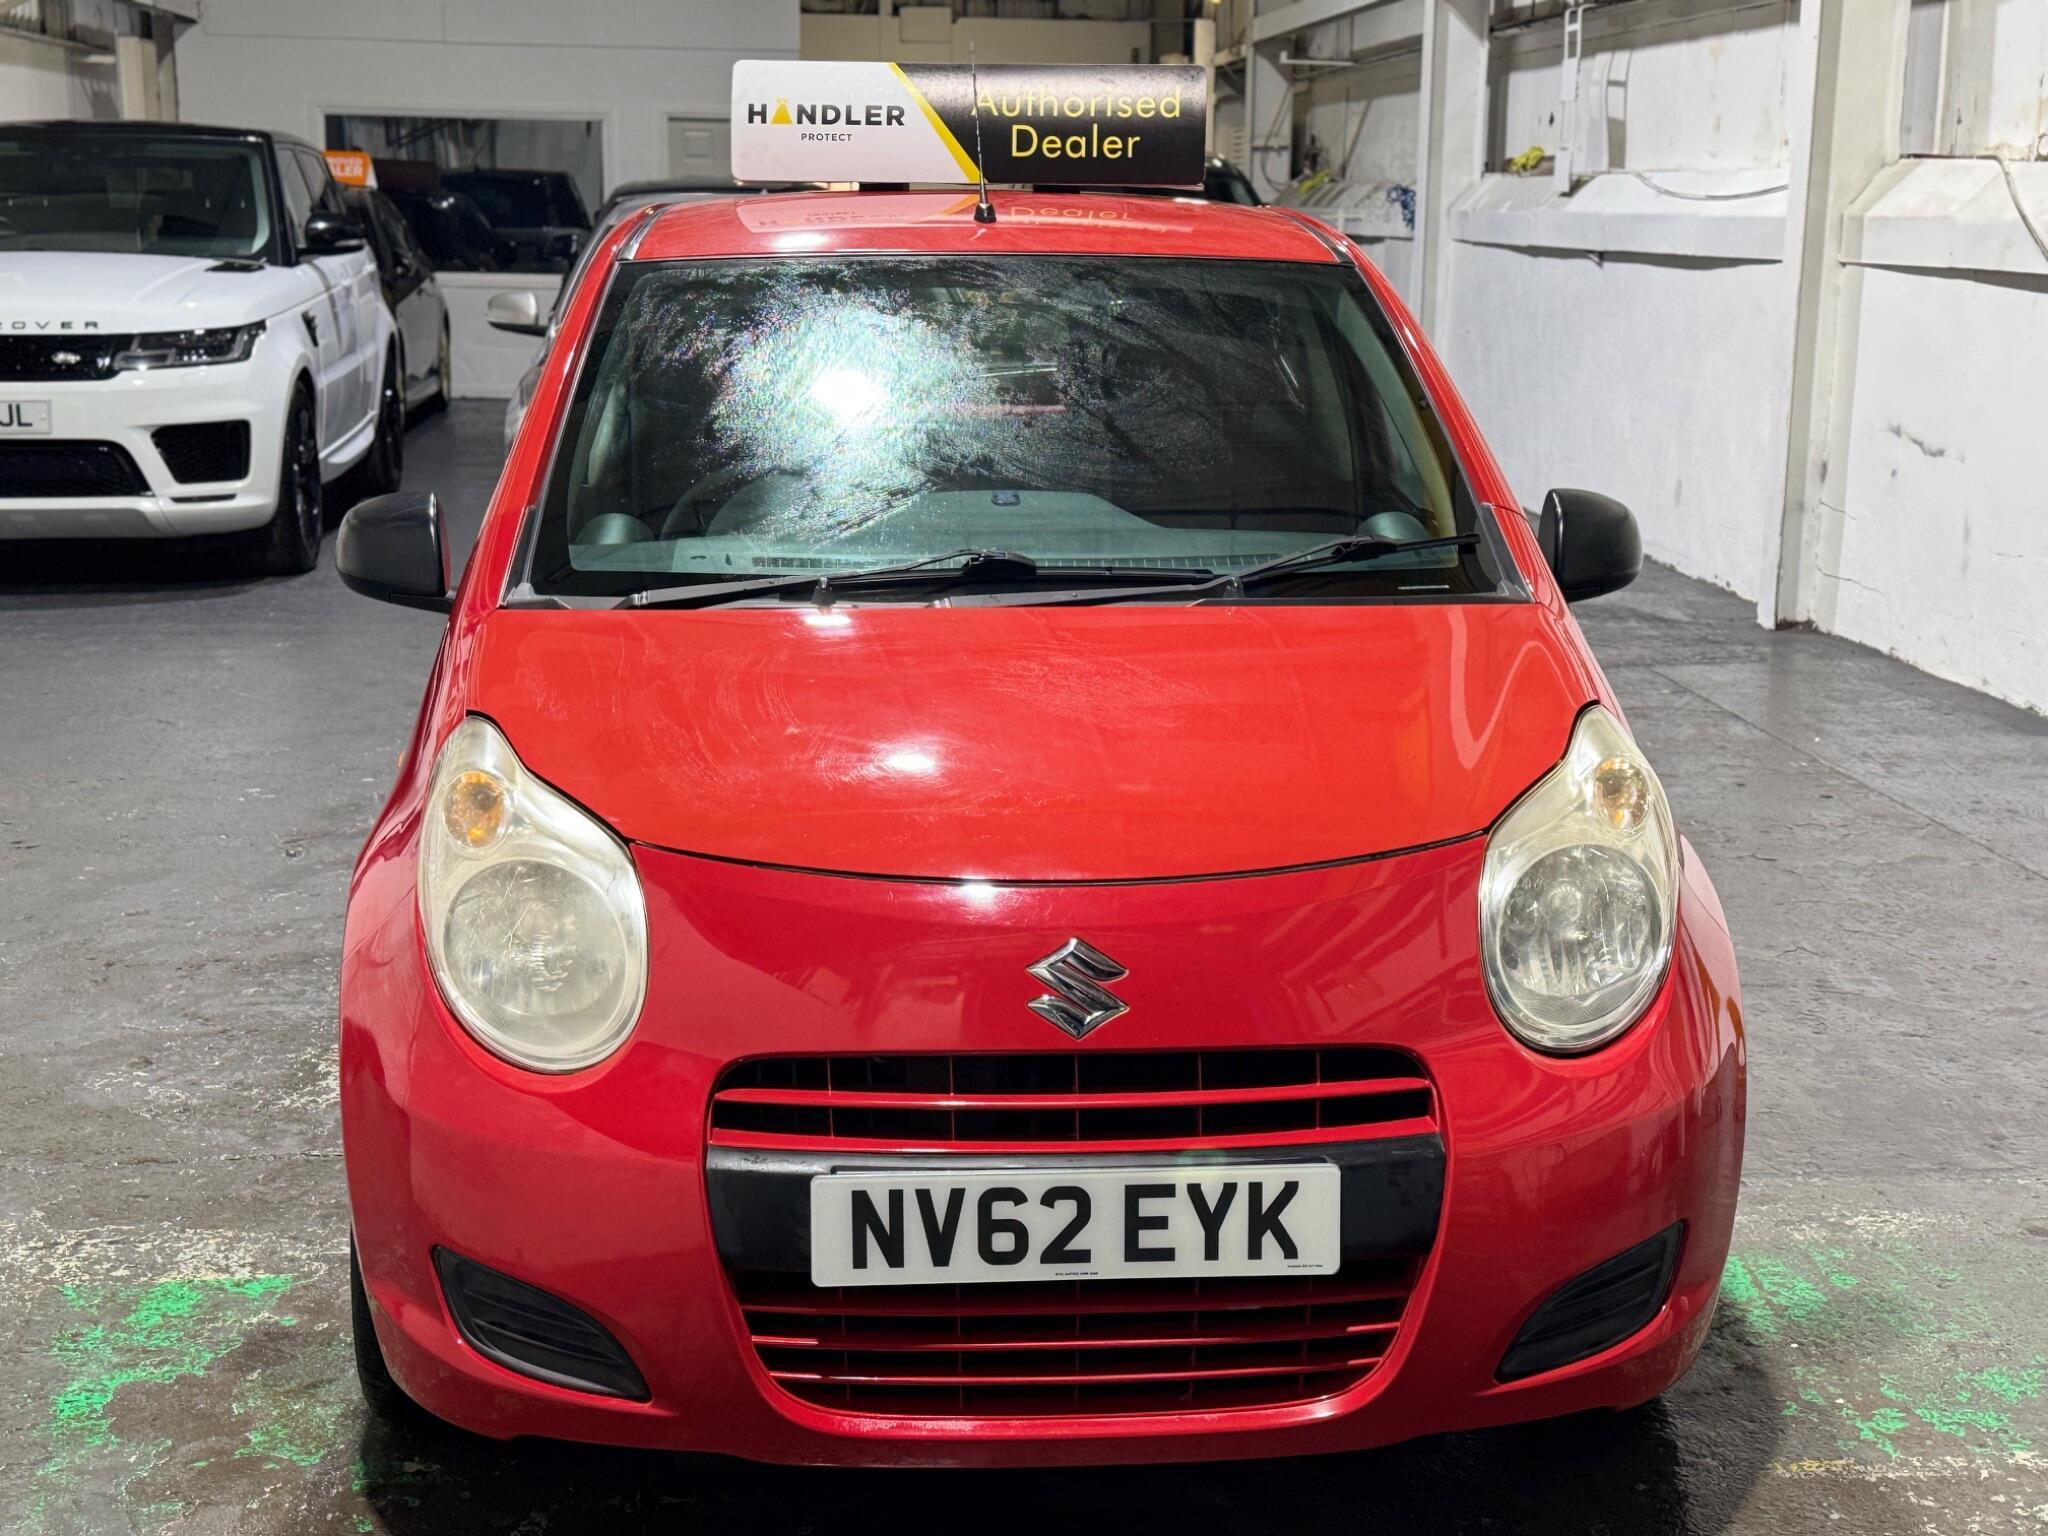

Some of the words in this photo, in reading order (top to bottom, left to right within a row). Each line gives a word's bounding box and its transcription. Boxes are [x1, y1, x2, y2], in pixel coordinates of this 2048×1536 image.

[971, 84, 1181, 118] Authorised
[801, 132, 852, 141] PROTECT
[1011, 123, 1140, 158] Dealer
[0, 321, 98, 330] OVER
[851, 1186, 1092, 1269] NV62
[1124, 1181, 1299, 1262] EYK
